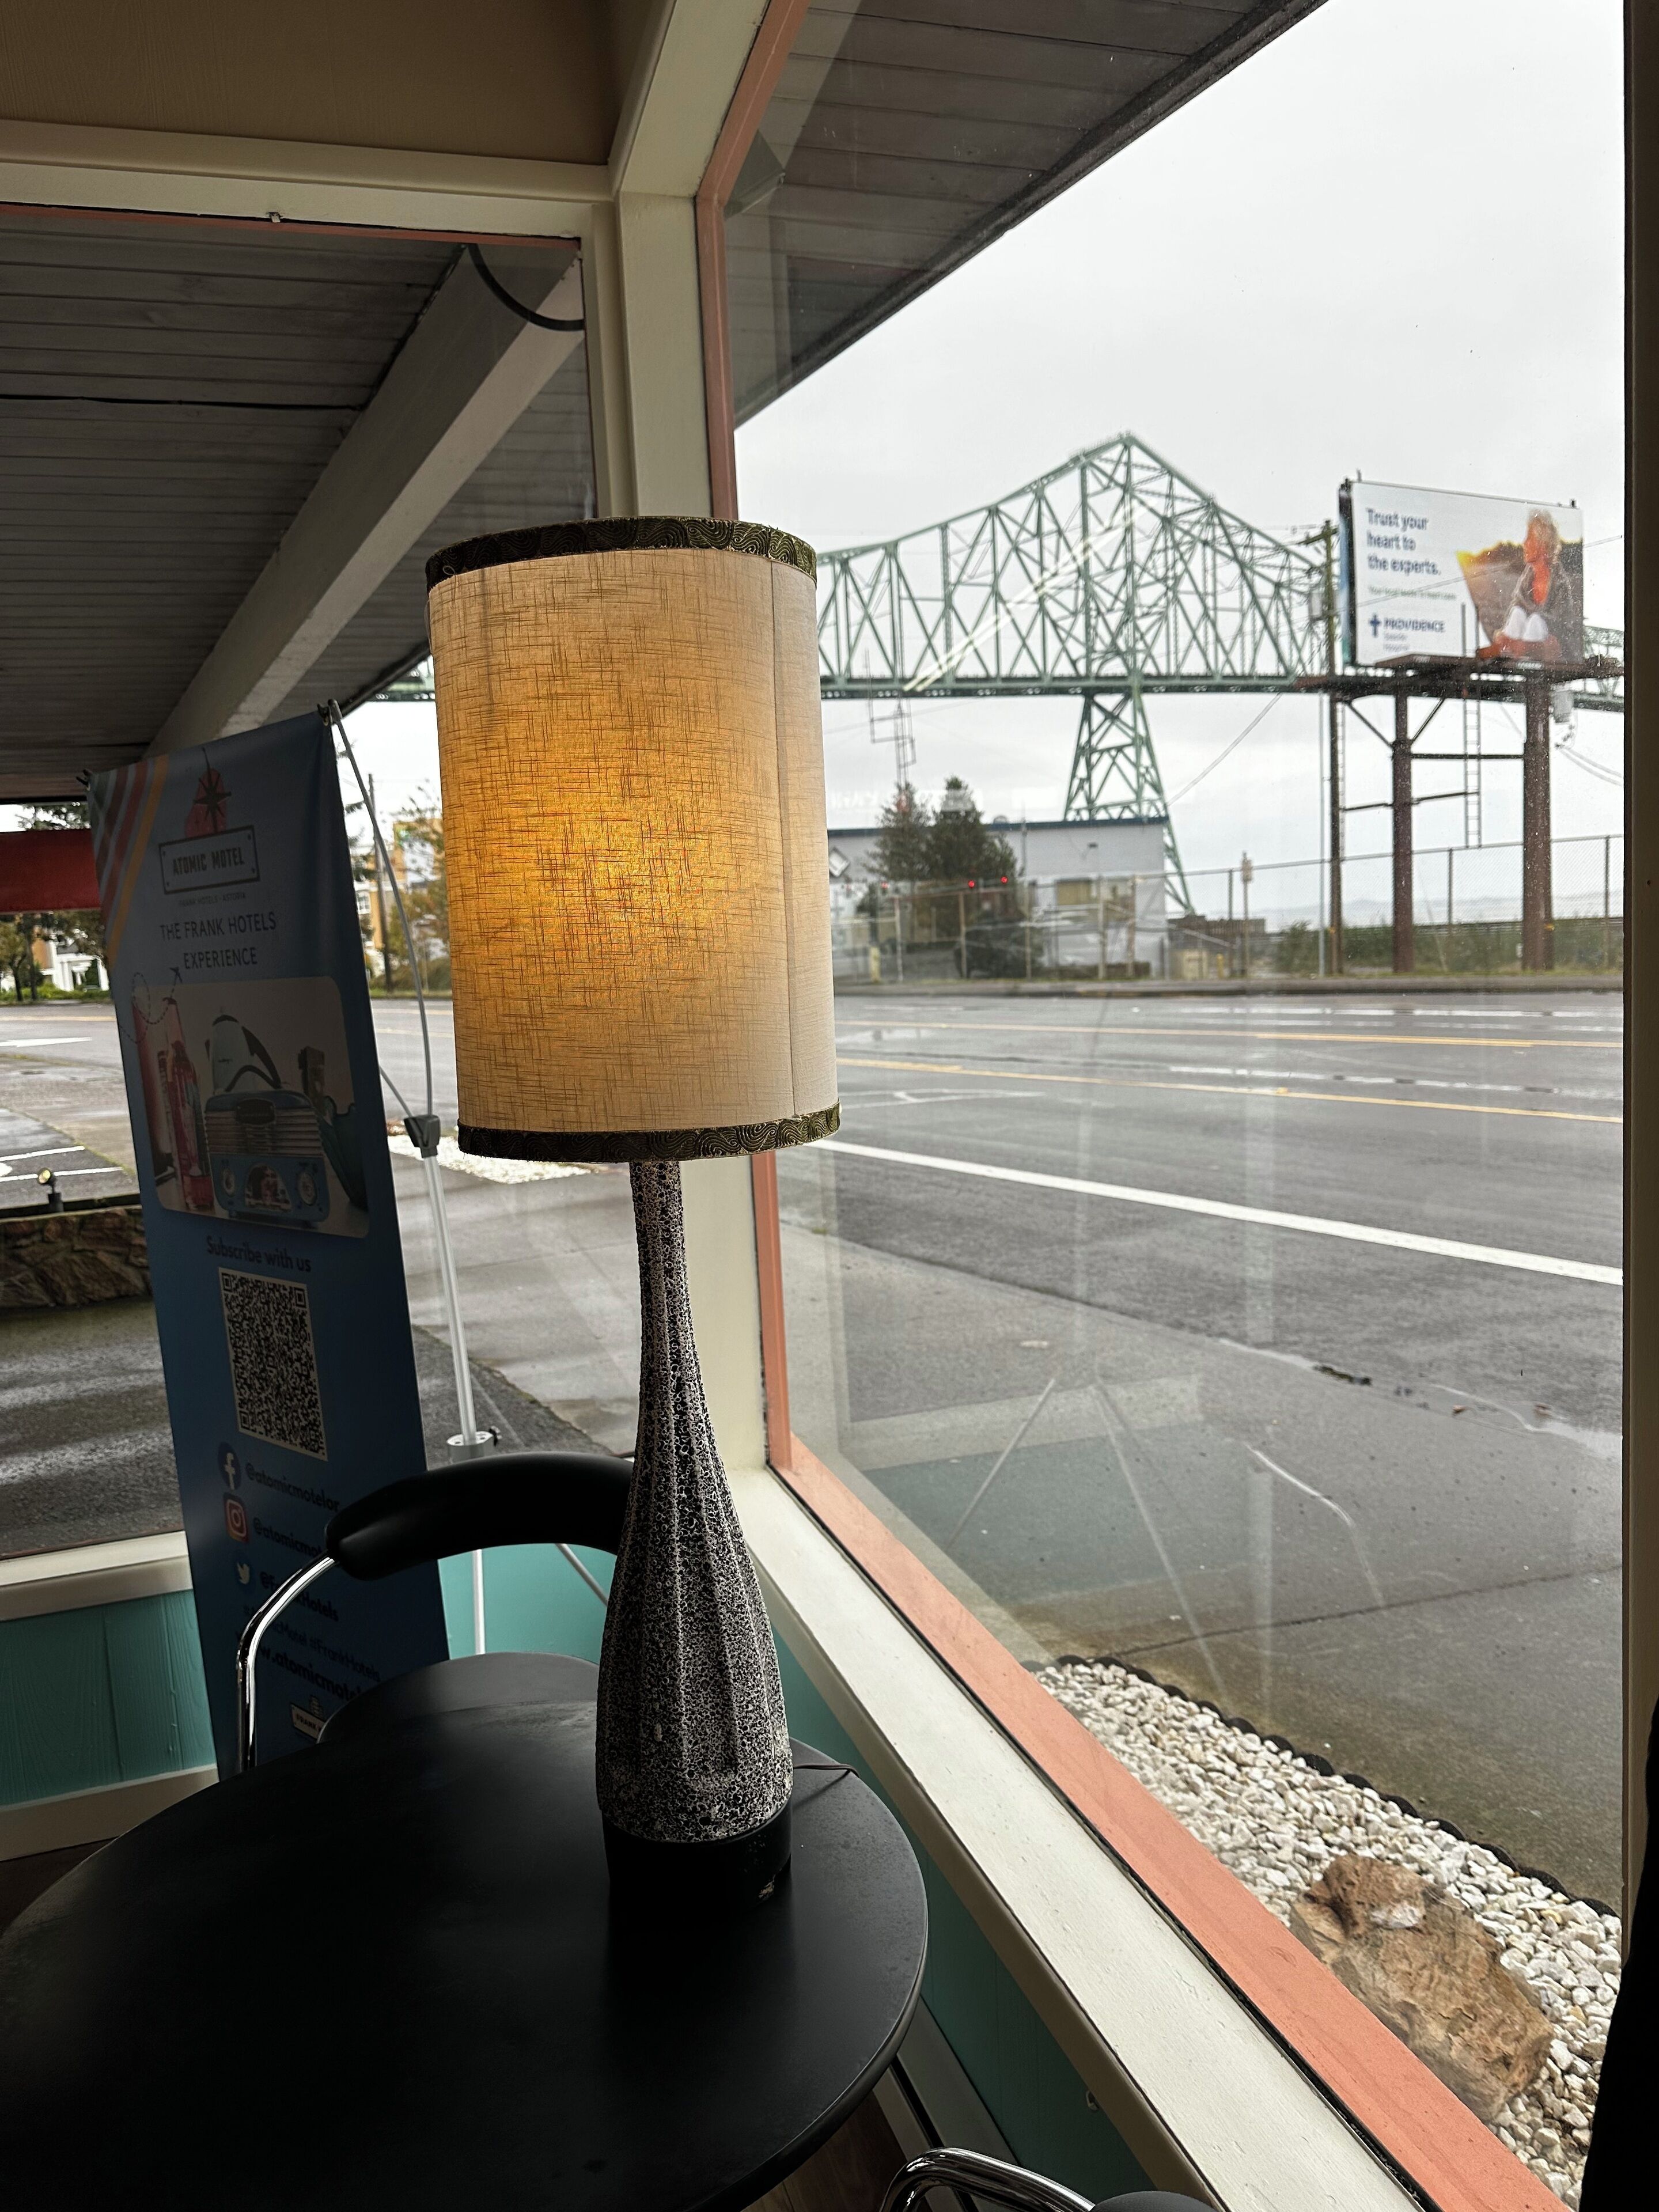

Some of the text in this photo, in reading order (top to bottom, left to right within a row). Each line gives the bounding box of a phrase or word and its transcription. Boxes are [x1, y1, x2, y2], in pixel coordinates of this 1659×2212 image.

[1366, 507, 1429, 532] Trust your
[1366, 530, 1416, 551] heart to
[1368, 553, 1442, 576] the experts.
[1384, 618, 1446, 633] PROVIDENCE
[173, 847, 245, 876] ATOMIC MOTEL
[222, 892, 247, 902] ASTORIA
[160, 911, 276, 941] THE FRANK HOTELS
[184, 947, 258, 969] EXPERIENCE
[207, 1235, 312, 1272] Subscribe with us
[245, 1463, 341, 1512] @atomicmotelor
[253, 1517, 323, 1556] @atomicmot
